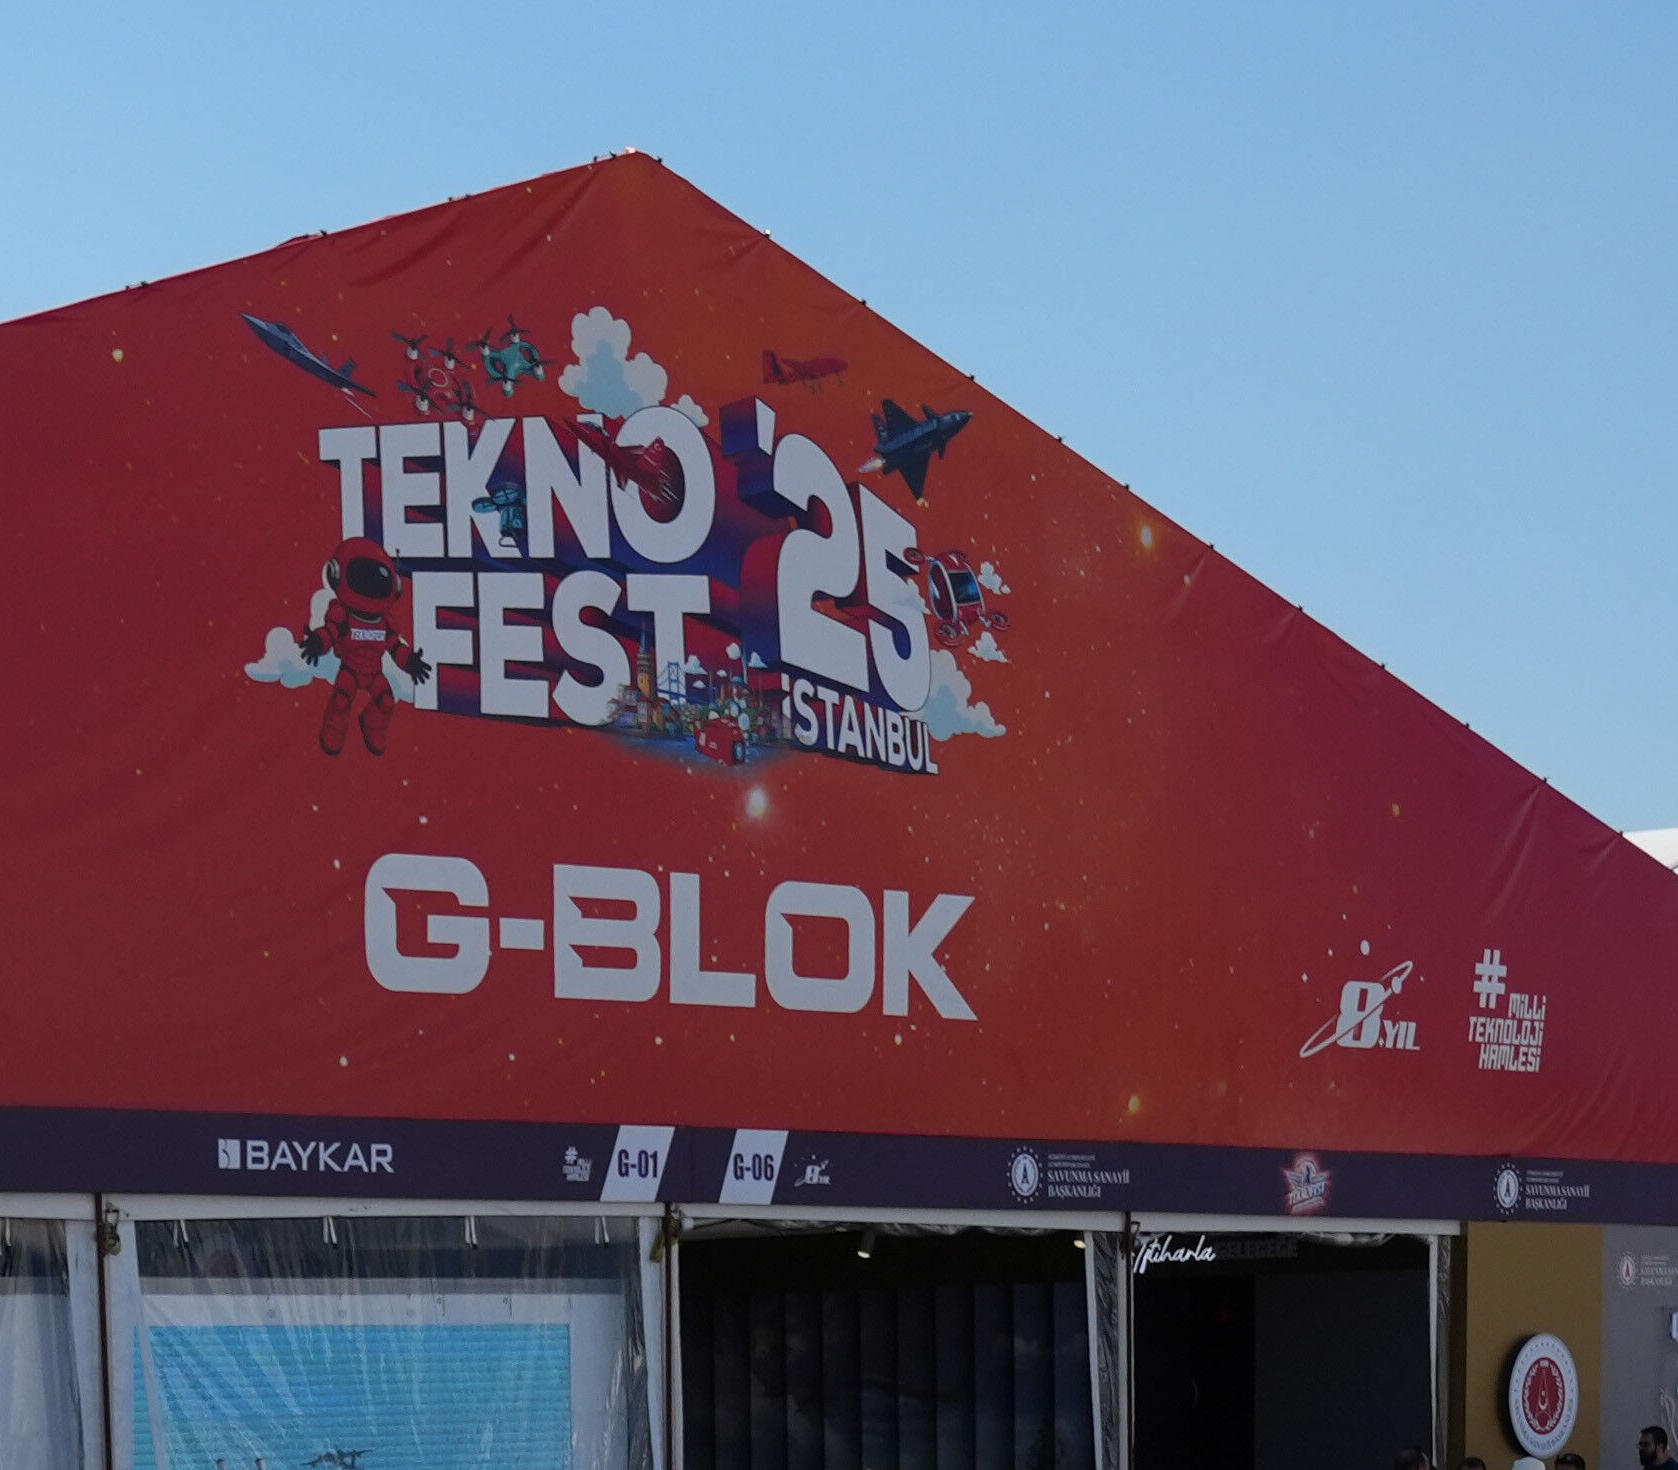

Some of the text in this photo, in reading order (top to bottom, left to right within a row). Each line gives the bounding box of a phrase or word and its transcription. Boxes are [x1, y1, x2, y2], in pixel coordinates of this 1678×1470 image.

[317, 406, 715, 562] TEKNO
[412, 570, 710, 727] FEST
[364, 852, 979, 1022] G-BLOK
[246, 1139, 395, 1174] BAYKAR
[617, 1149, 658, 1178] G-01
[733, 1153, 774, 1181] G-06
